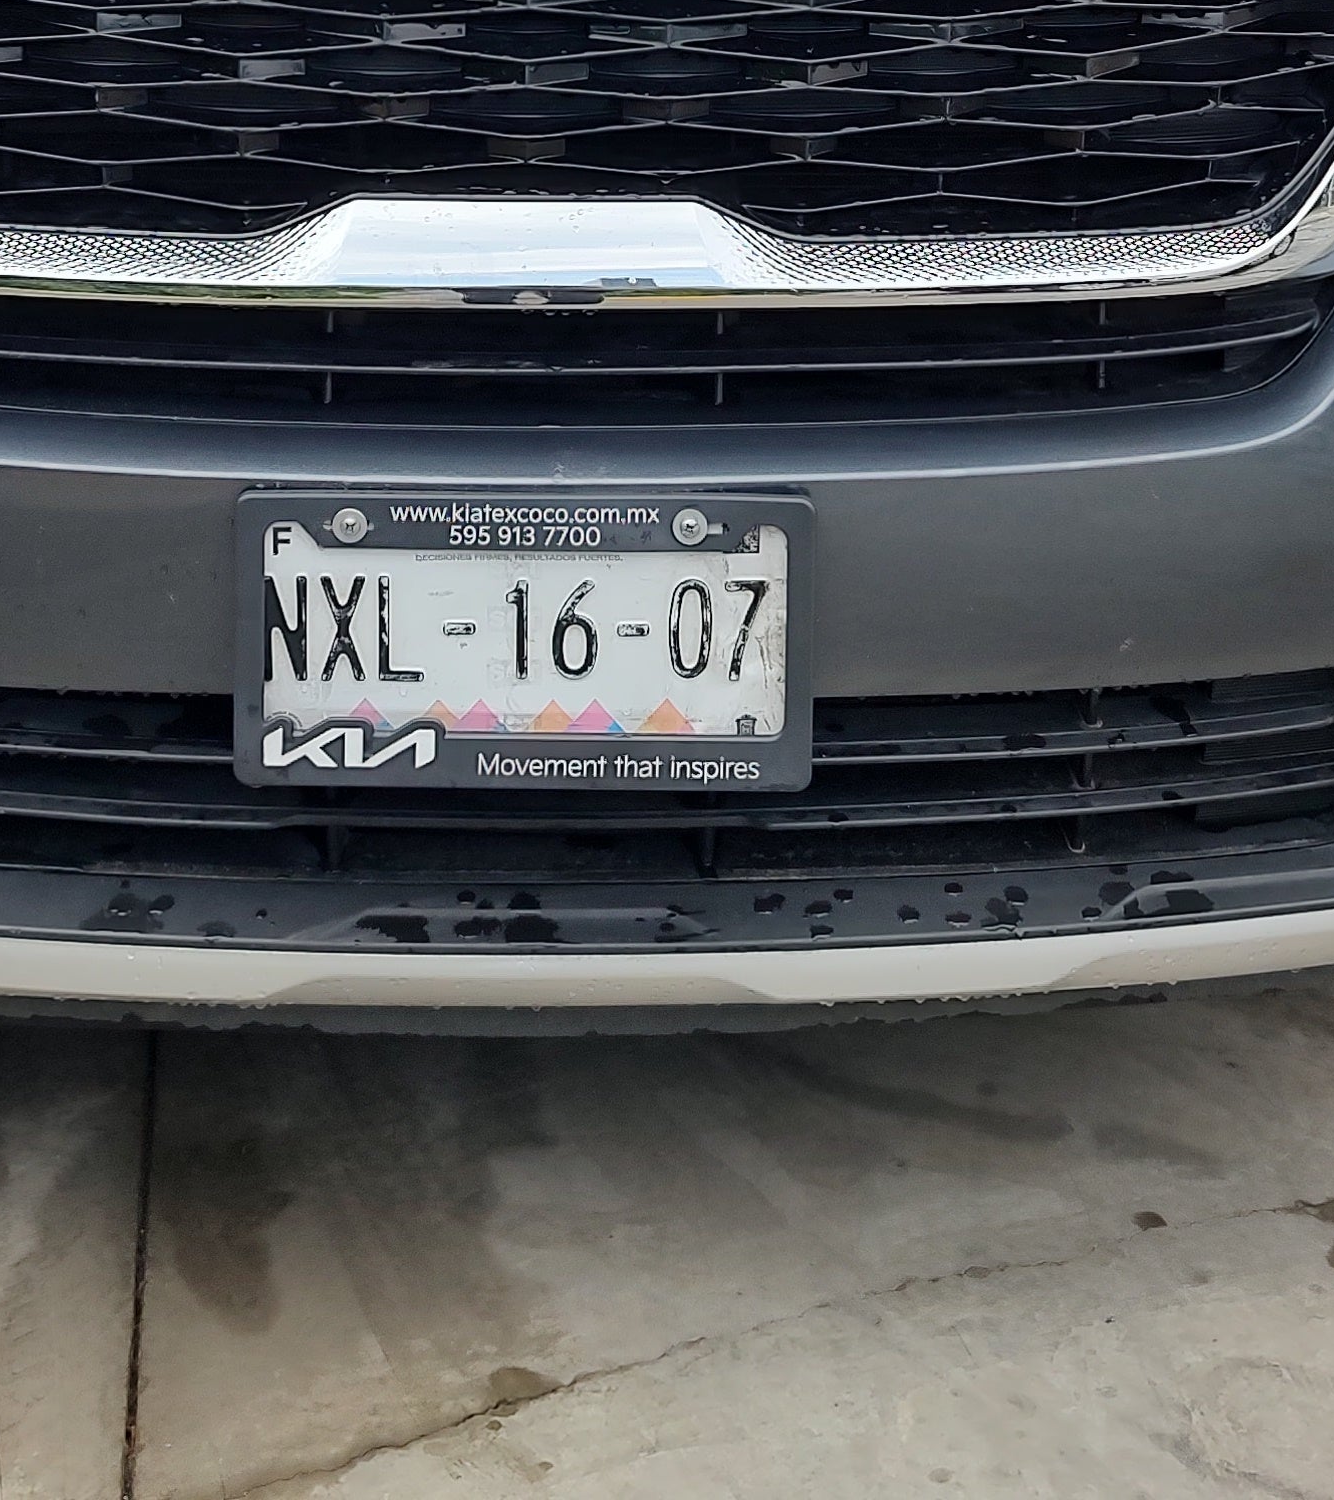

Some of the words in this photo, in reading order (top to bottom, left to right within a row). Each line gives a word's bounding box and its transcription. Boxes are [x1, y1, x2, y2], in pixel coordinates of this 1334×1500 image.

[389, 503, 660, 524] www.kiatexcoco.com.mx
[272, 526, 292, 556] F
[449, 526, 491, 546] 595
[497, 526, 536, 546] 913
[542, 526, 601, 547] 7700
[263, 726, 436, 769] KIA
[477, 752, 607, 777] Movement
[614, 754, 663, 778] that
[669, 756, 761, 785] inspires
